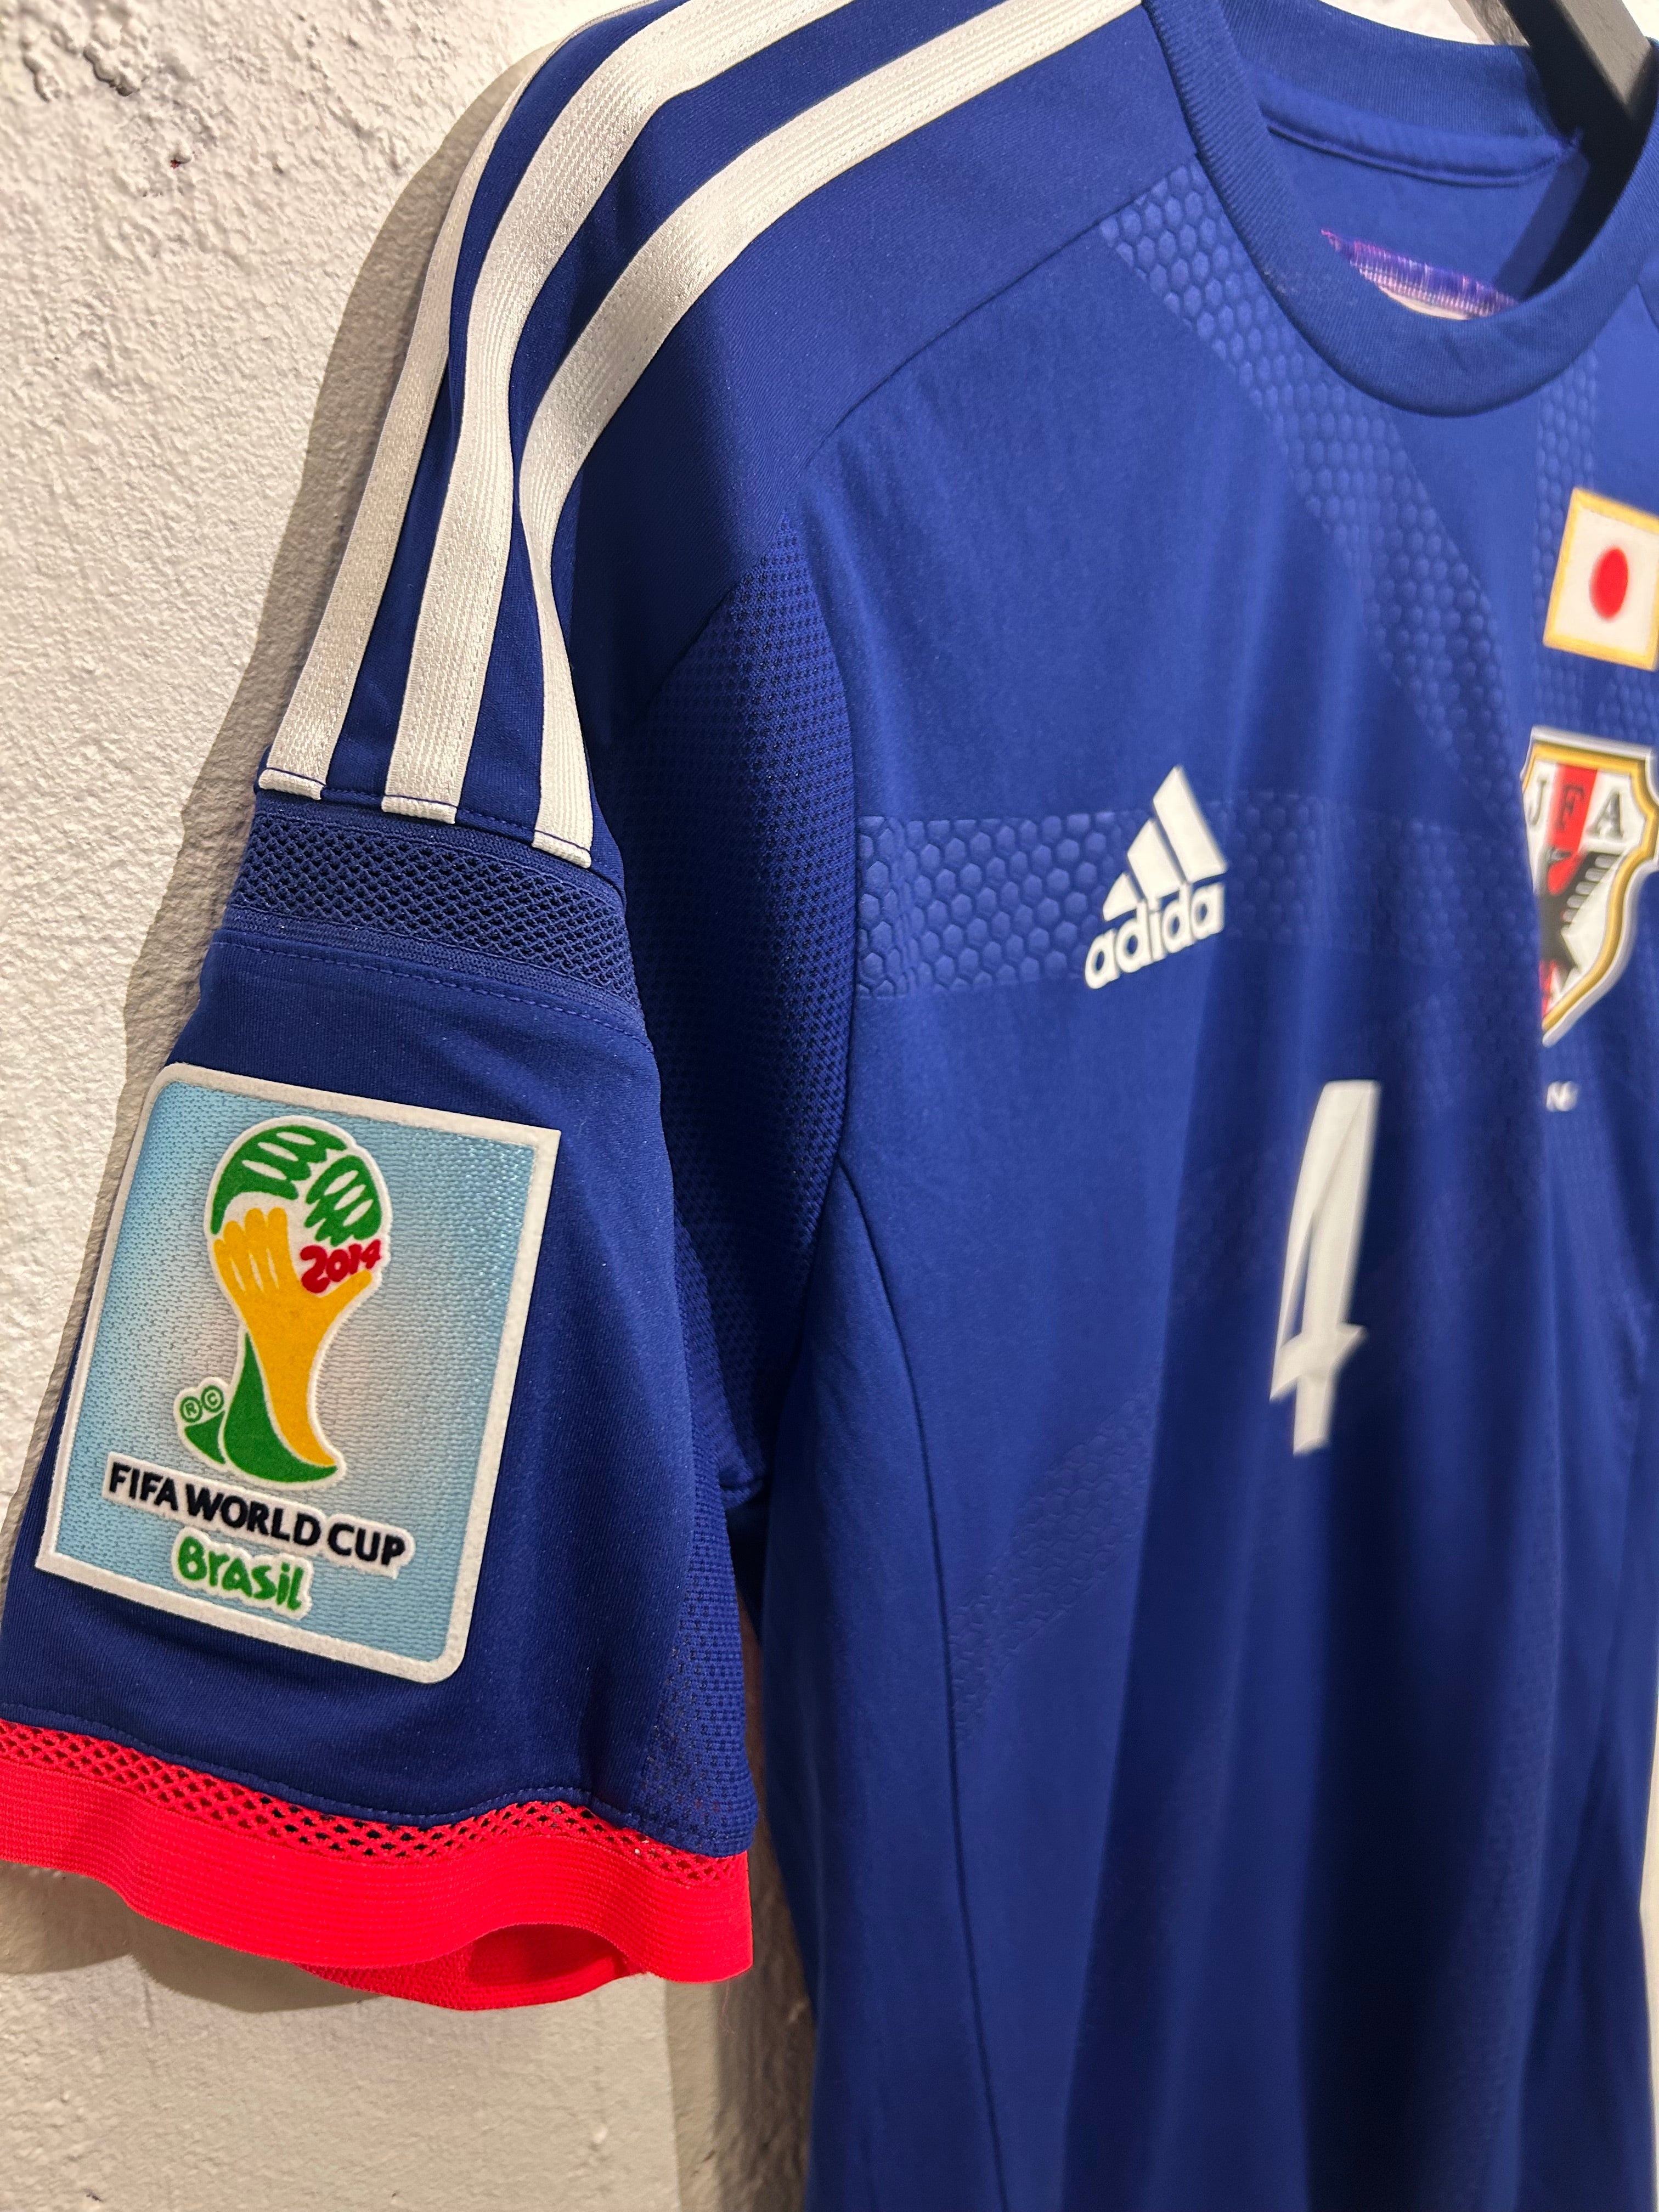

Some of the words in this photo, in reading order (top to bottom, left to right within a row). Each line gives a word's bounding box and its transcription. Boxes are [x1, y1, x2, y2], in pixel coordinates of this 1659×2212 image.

[1527, 778, 1625, 839] JFA
[1085, 880, 1227, 989] adida
[300, 1239, 382, 1293] 2014
[1269, 1079, 1380, 1457] 4
[109, 1462, 179, 1511] FIFA
[185, 1483, 322, 1547] WORLD
[328, 1522, 405, 1566] CUP
[178, 1536, 304, 1611] Brasil
